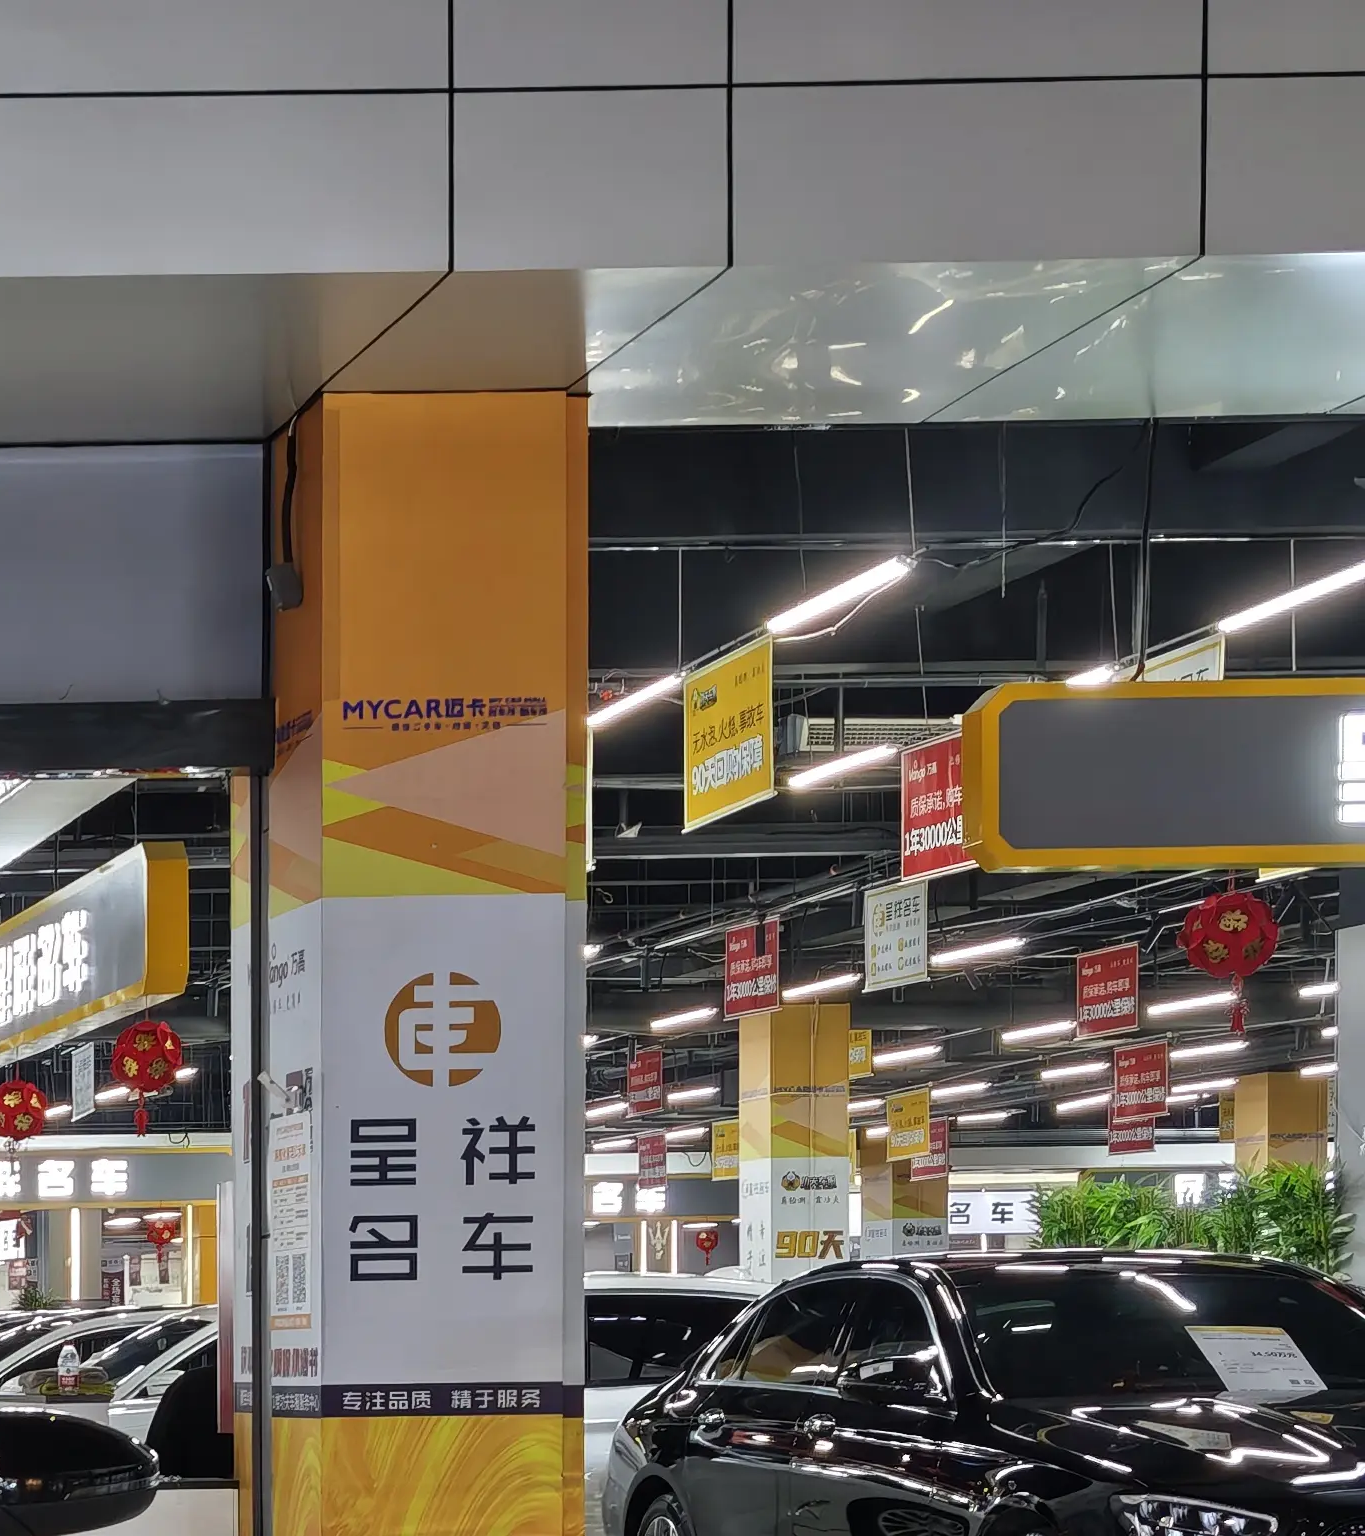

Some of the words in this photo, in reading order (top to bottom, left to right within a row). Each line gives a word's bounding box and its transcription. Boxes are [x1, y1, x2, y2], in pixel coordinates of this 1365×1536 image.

[349, 1115, 536, 1187] 呈祥
[949, 1201, 1014, 1225] 名车
[348, 1212, 534, 1282] 名车
[775, 1229, 845, 1260] 90天
[342, 1388, 432, 1411] 专注品质
[451, 1386, 541, 1409] 精于服务
